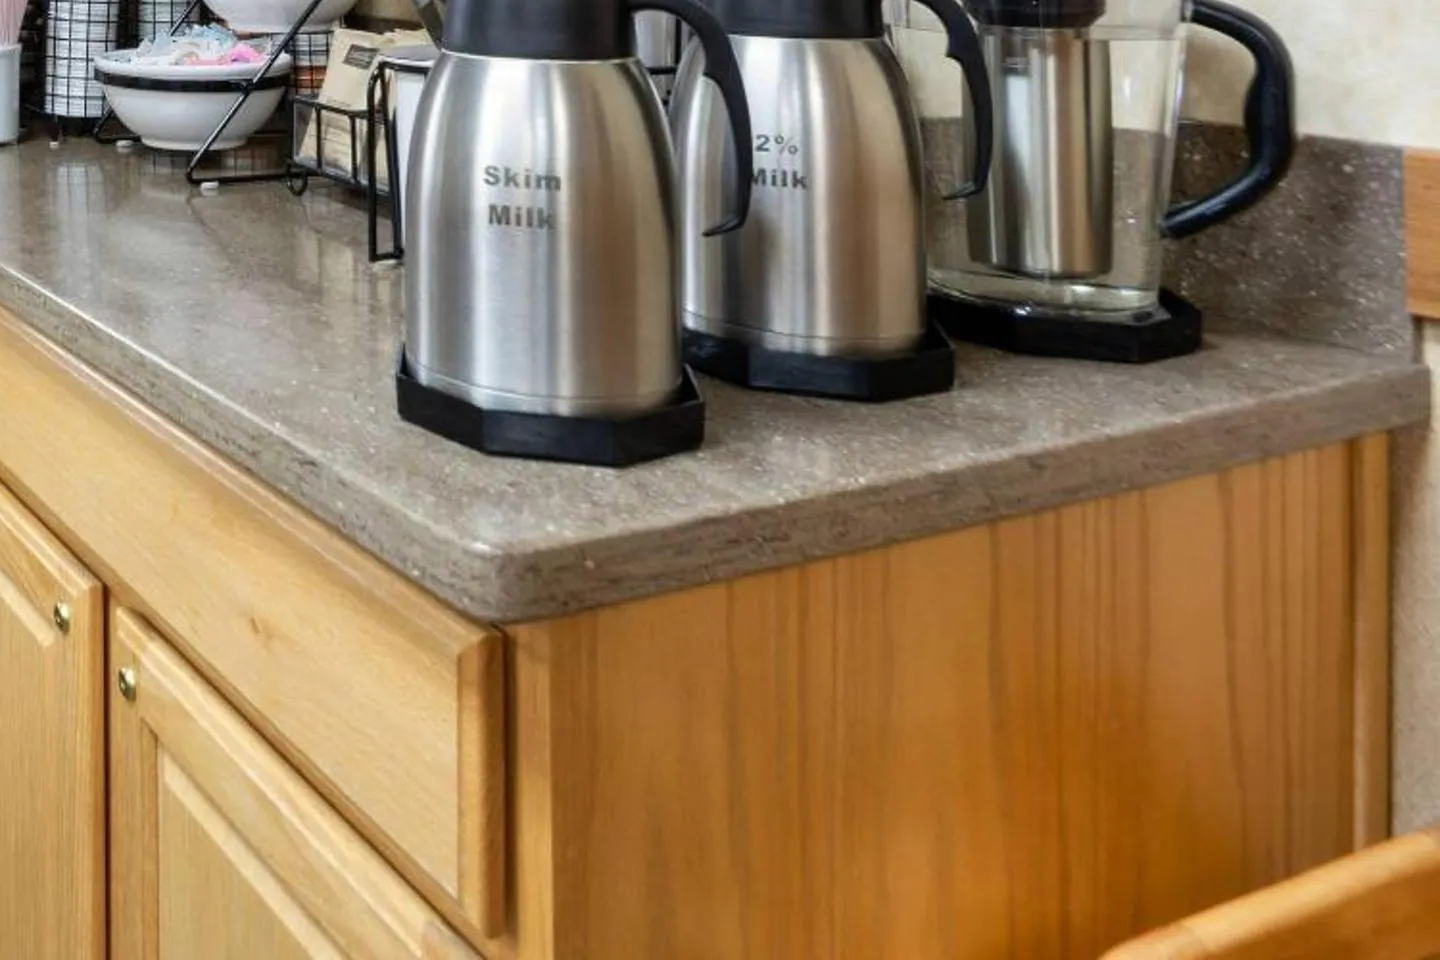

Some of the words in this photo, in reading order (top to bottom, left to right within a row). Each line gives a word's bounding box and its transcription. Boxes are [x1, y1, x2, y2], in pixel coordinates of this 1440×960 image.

[755, 134, 799, 155] 2%
[483, 165, 561, 191] Skim
[488, 204, 556, 230] Milk
